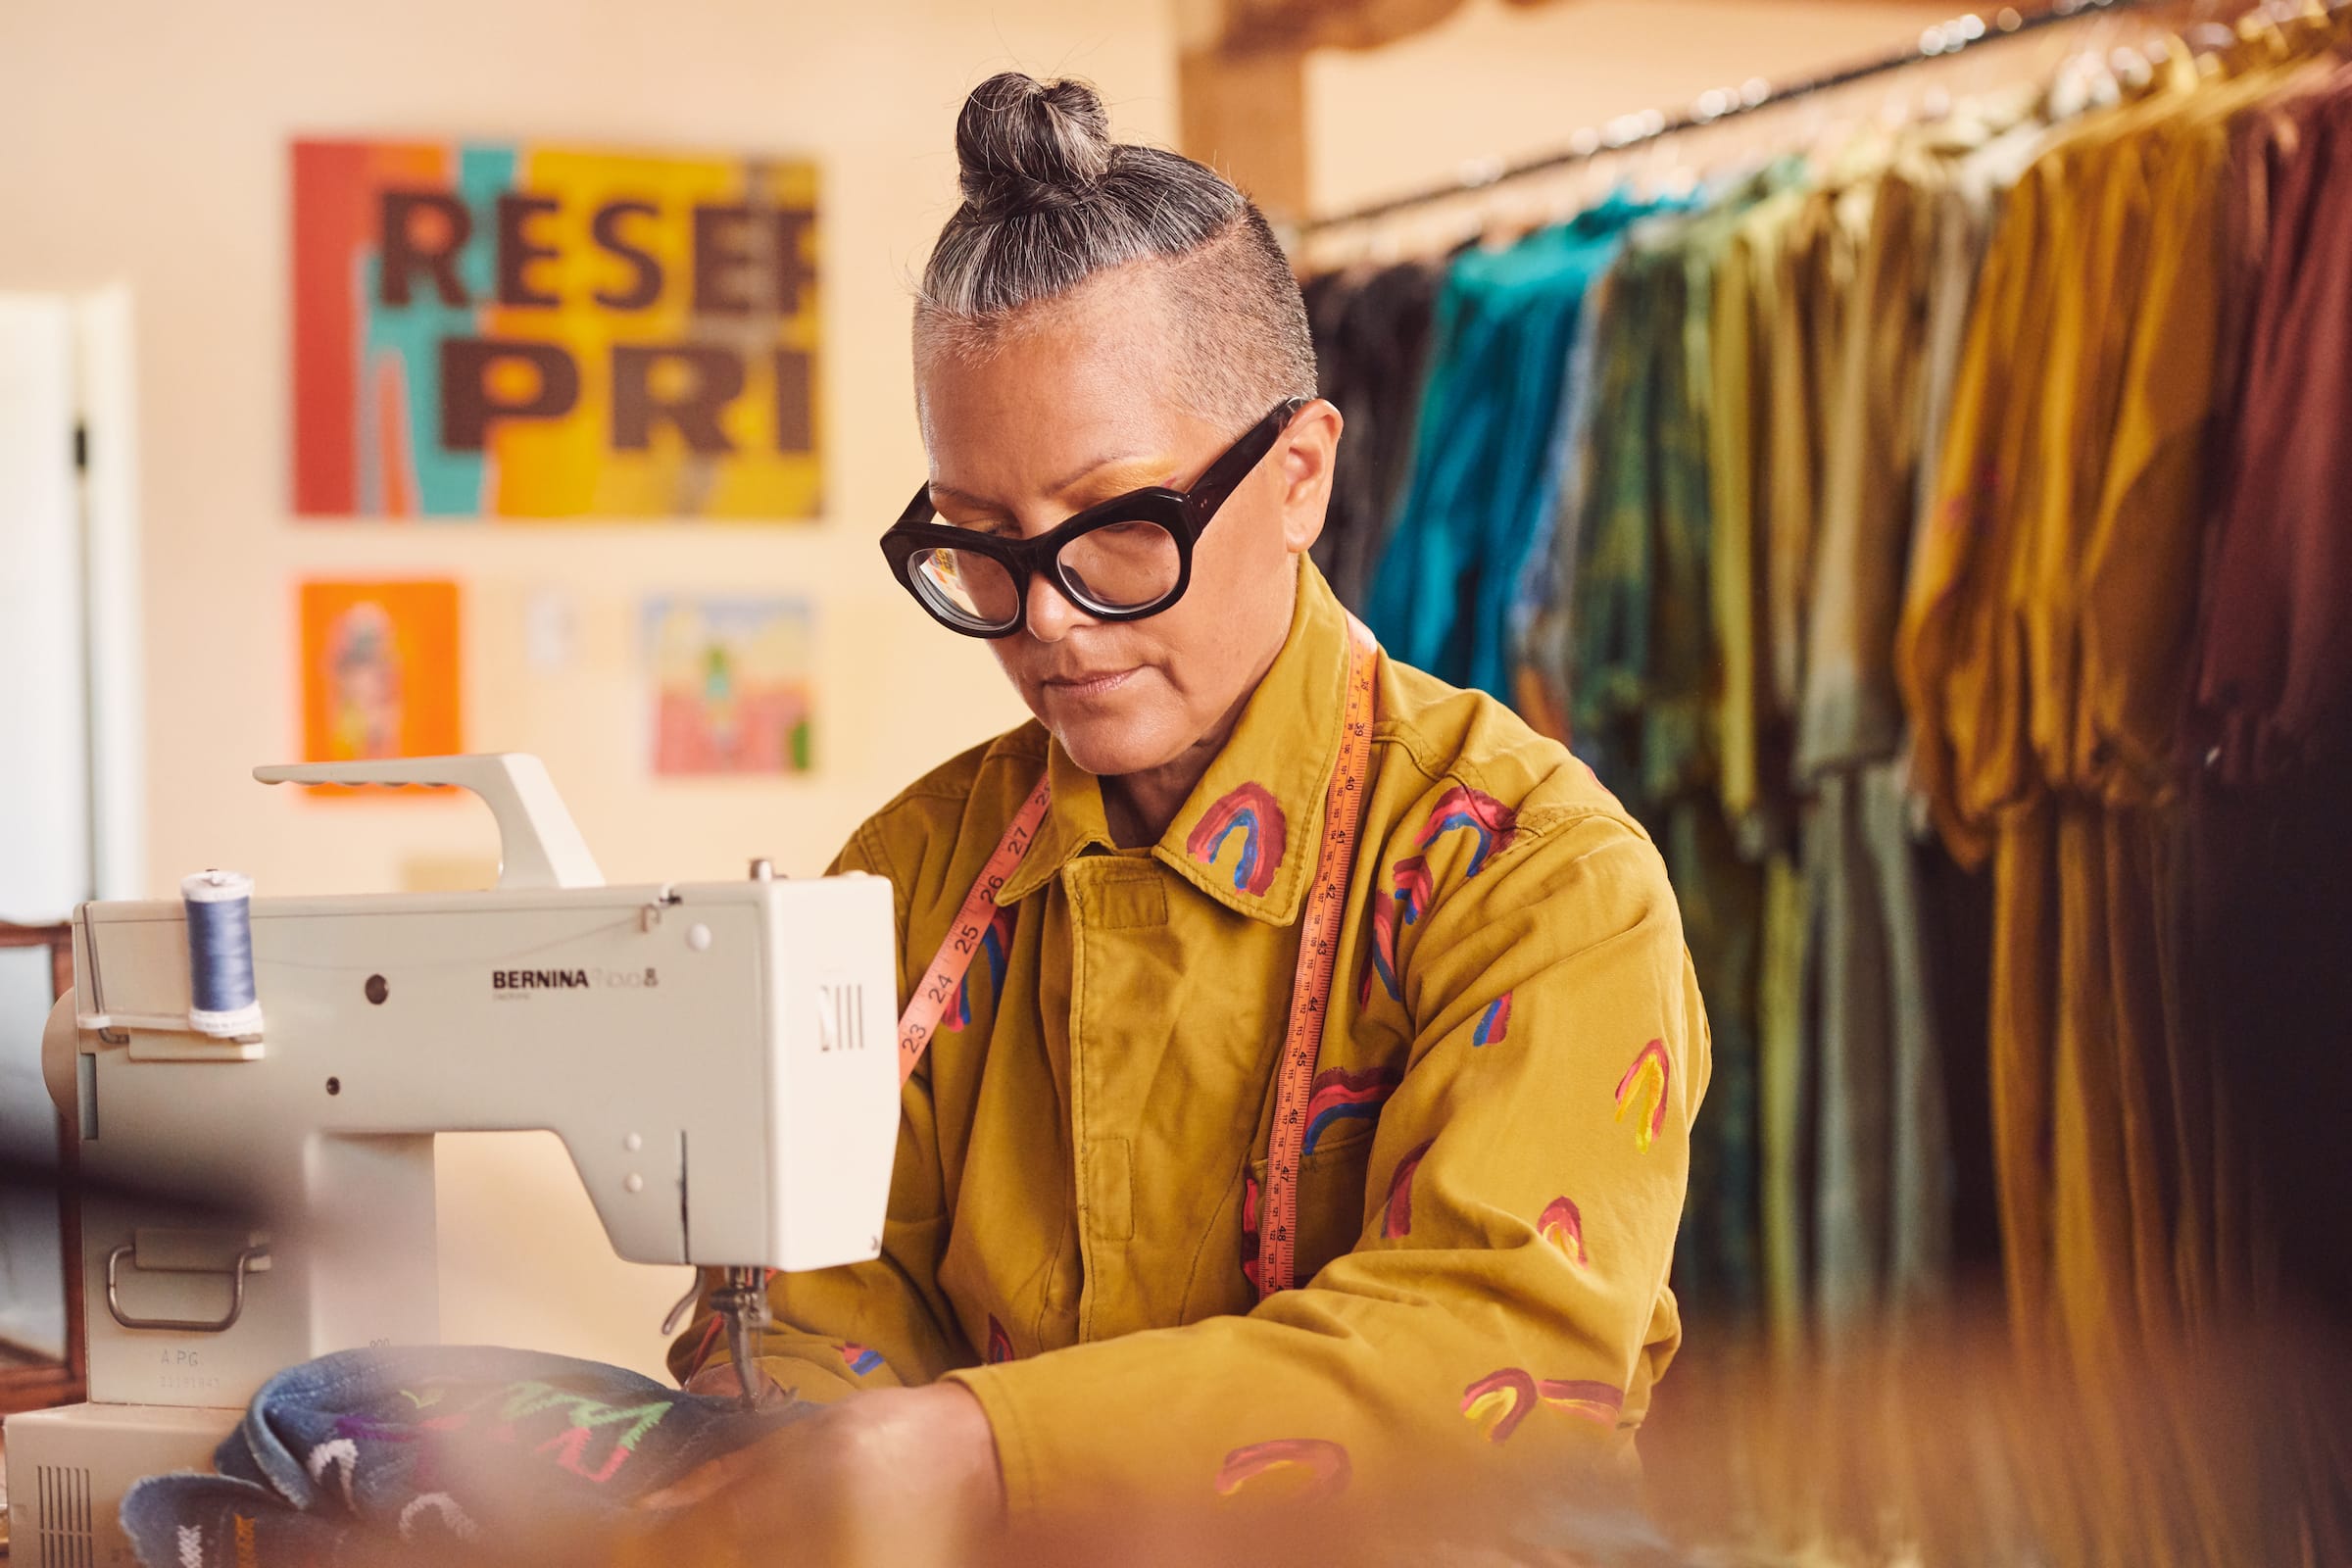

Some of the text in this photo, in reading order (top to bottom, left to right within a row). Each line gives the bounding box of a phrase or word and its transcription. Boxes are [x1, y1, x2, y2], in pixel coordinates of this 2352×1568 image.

[441, 338, 812, 455] PRI
[1355, 723, 1364, 736] 39
[1346, 776, 1354, 790] 40
[1338, 830, 1346, 844] 41
[1326, 884, 1336, 900] 42
[902, 1023, 925, 1054] 23
[928, 974, 953, 1004] 24
[955, 924, 978, 955] 25
[980, 875, 1004, 904] 26
[1007, 826, 1027, 855] 27
[1317, 941, 1327, 956] 43
[492, 969, 590, 989] BERNINA
[1308, 997, 1317, 1011] 44
[1297, 1052, 1306, 1066] 45
[1290, 1108, 1298, 1124] 46
[1281, 1166, 1289, 1182] 47
[1277, 1225, 1286, 1241] 48
